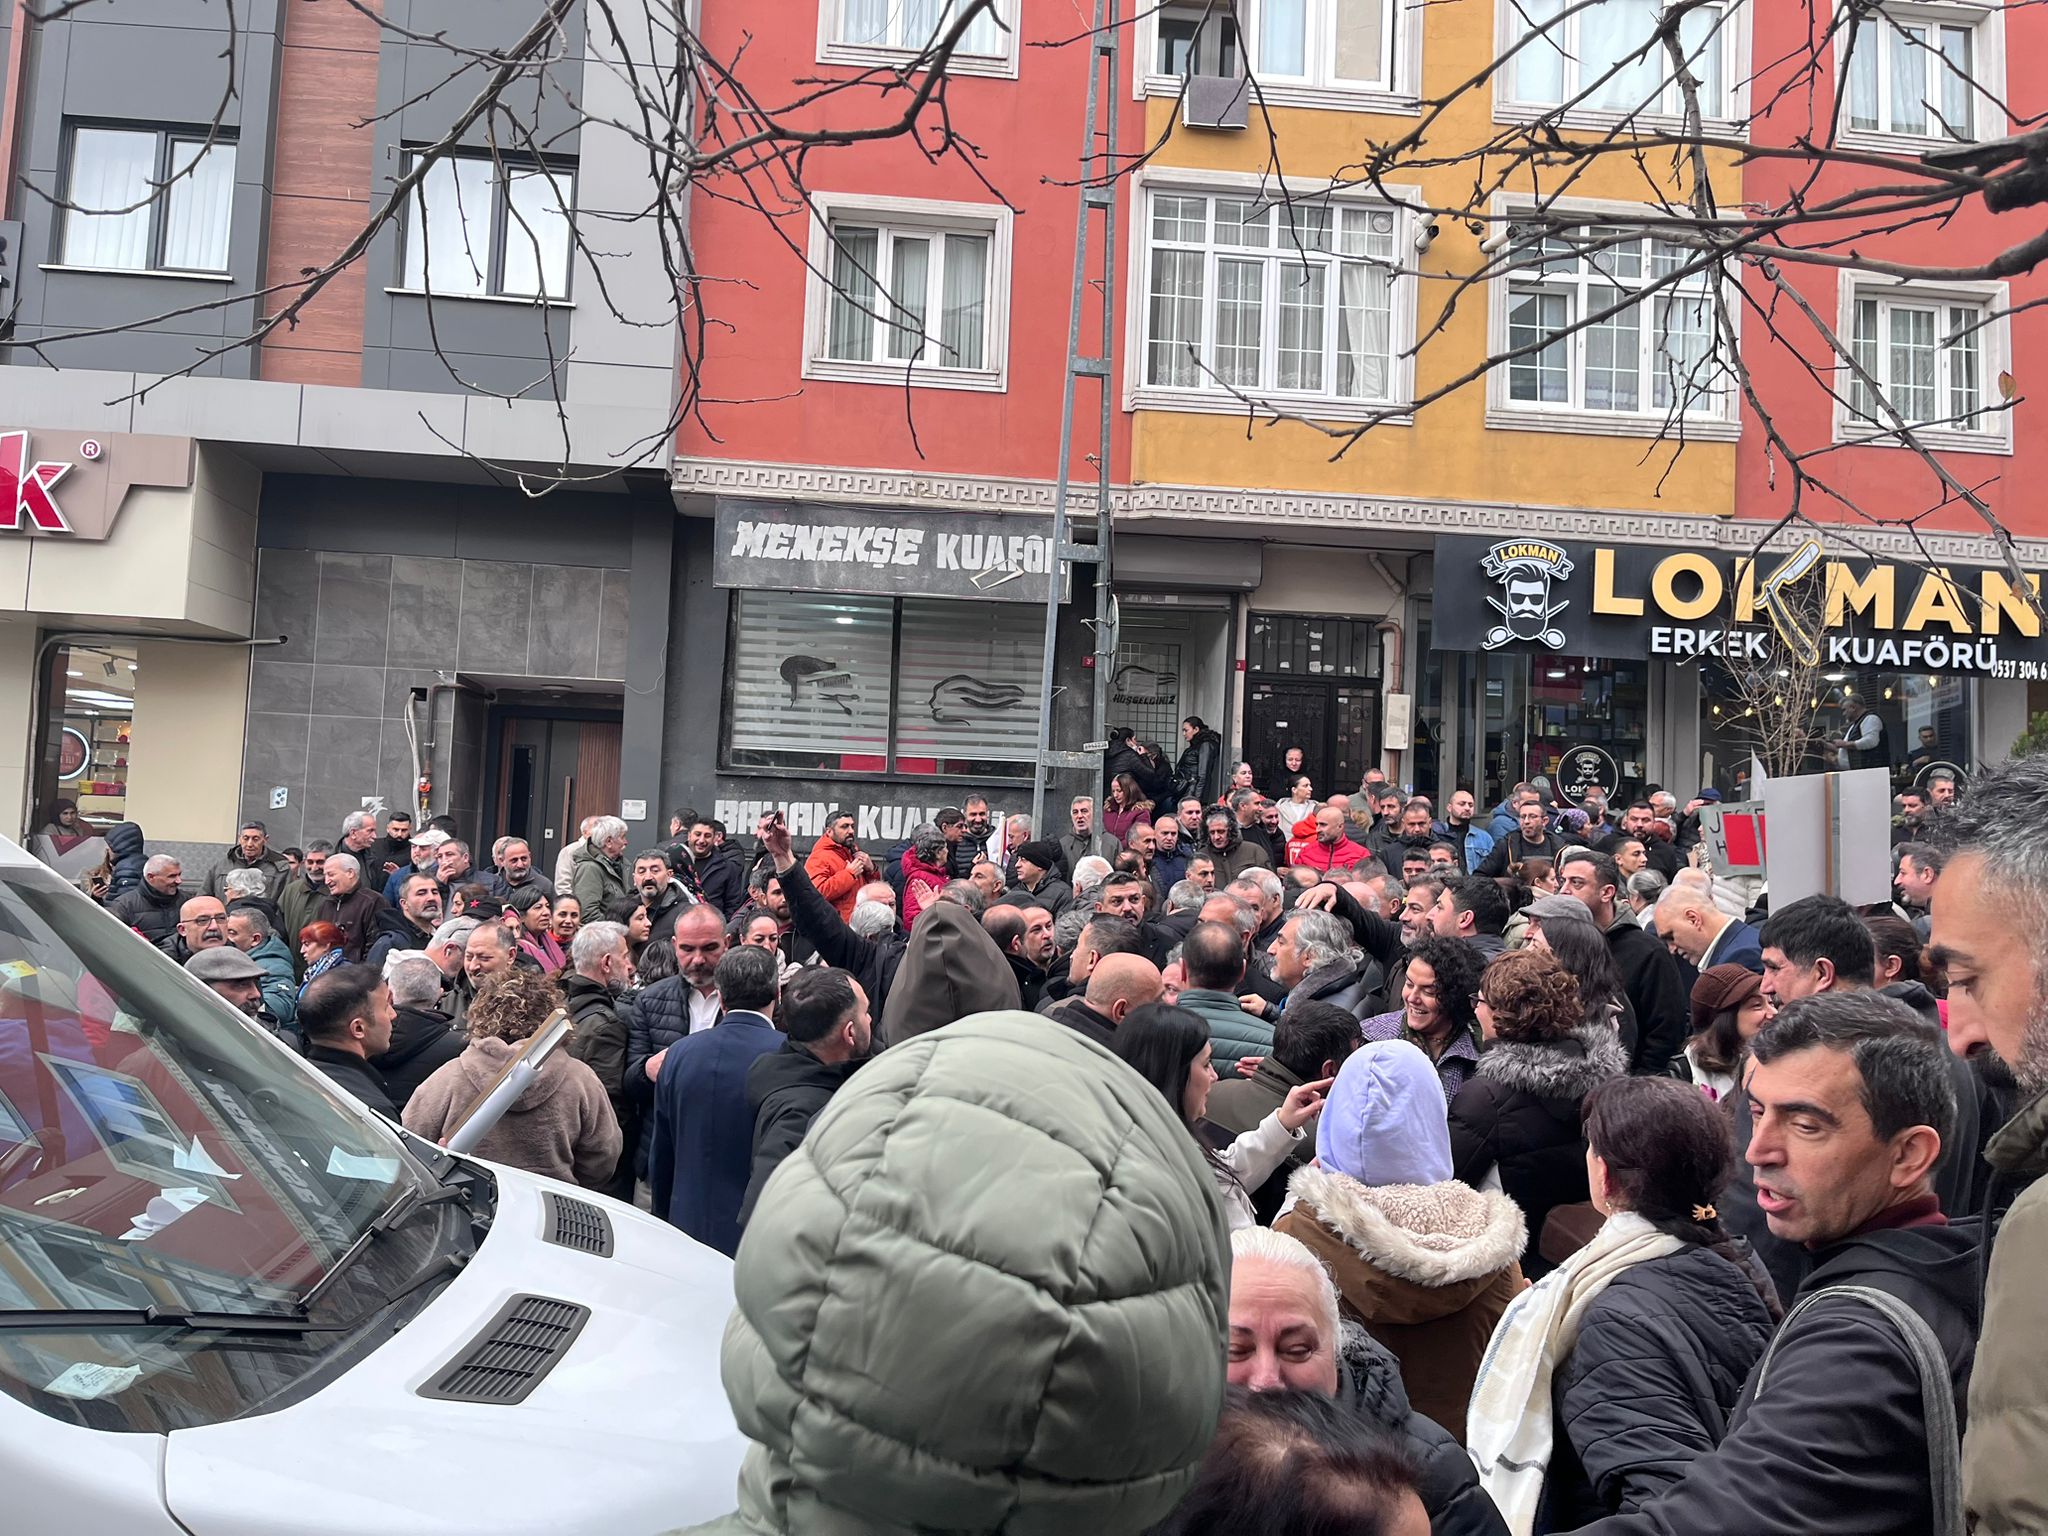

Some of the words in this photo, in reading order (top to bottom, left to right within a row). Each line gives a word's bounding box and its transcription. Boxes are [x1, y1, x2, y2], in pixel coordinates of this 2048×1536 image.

[731, 520, 925, 568] MENEKŞE
[1500, 544, 1559, 563] LOKMAN
[1592, 540, 2041, 664] LOKMAN
[1652, 627, 1767, 658] ERKEK
[1829, 636, 1998, 670] KUAFÖRÜ
[1991, 659, 2016, 679] 0537
[2019, 660, 2038, 680] 304
[2040, 661, 2048, 680] 6
